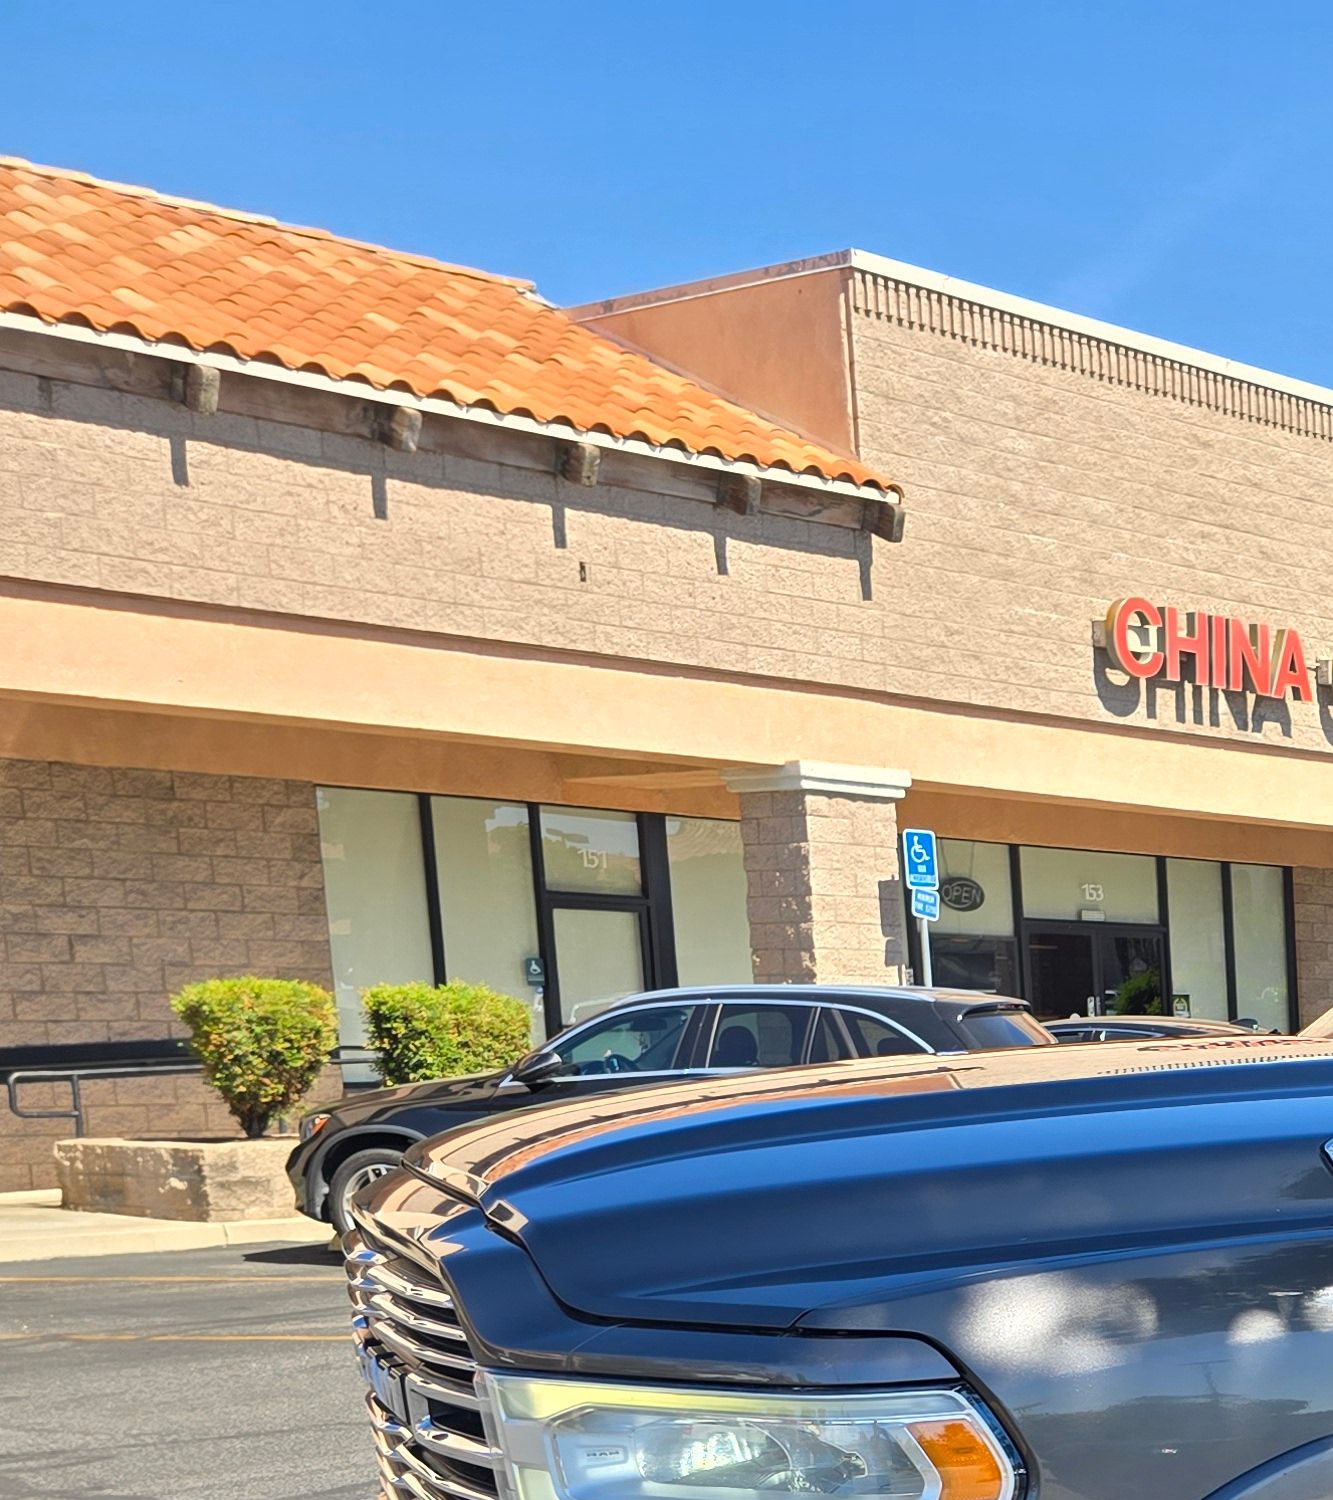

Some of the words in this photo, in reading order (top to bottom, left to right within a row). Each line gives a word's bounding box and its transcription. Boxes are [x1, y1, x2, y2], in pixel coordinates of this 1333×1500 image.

[1108, 597, 1313, 702] CHINA
[577, 848, 608, 869] 151
[942, 884, 981, 904] OPEN
[1081, 884, 1104, 901] 153
